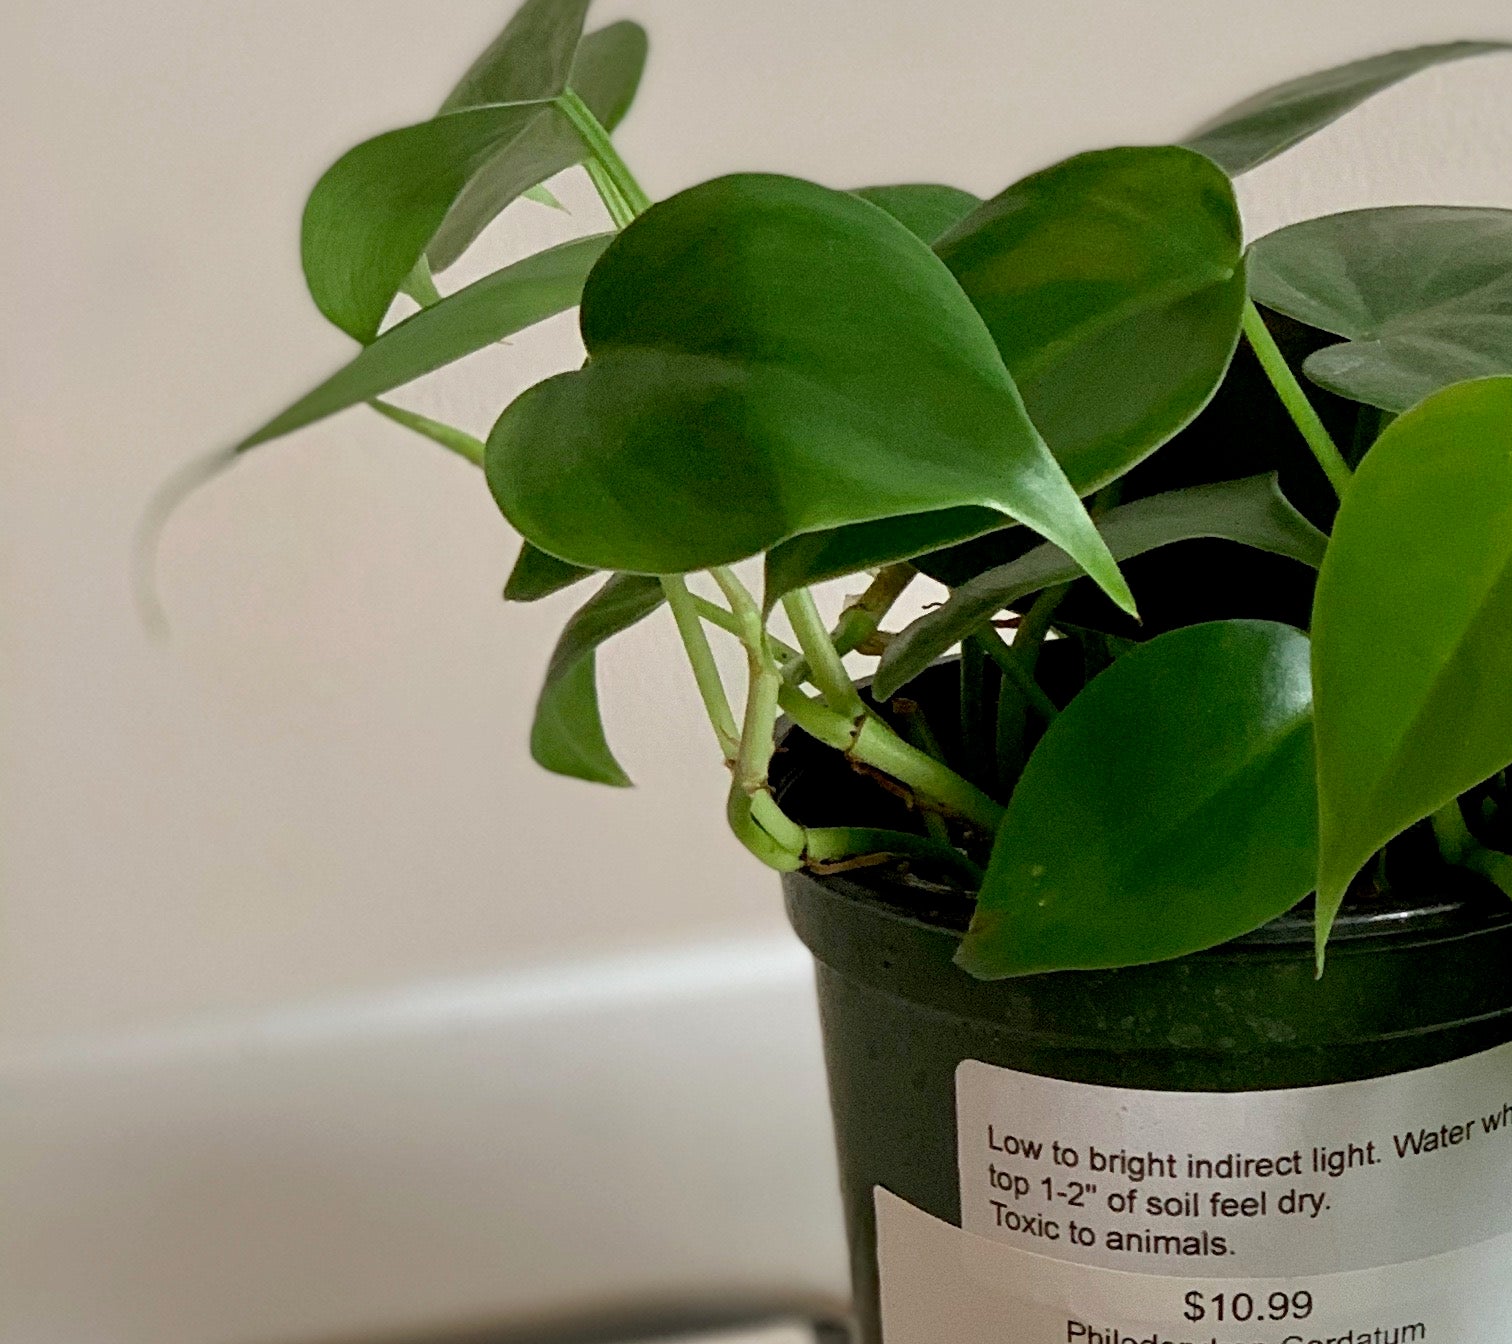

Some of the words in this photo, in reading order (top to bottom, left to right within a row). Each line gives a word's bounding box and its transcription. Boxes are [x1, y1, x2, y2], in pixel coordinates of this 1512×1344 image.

[987, 1124, 1044, 1161] Low
[1051, 1140, 1080, 1169] to
[1088, 1145, 1178, 1184] bright
[1186, 1149, 1303, 1180] indirect
[1312, 1140, 1382, 1178] light.
[1392, 1119, 1476, 1159] Water
[987, 1162, 1031, 1201] top
[1040, 1176, 1097, 1208] 1-2"
[1106, 1187, 1139, 1215] of
[1145, 1191, 1200, 1218] soil
[1208, 1190, 1267, 1218] feel
[1277, 1187, 1331, 1219] dry.
[988, 1199, 1061, 1241] Toxic
[1068, 1220, 1097, 1247] to
[1105, 1228, 1236, 1257] animals.
[1183, 1289, 1314, 1324] $10.99
